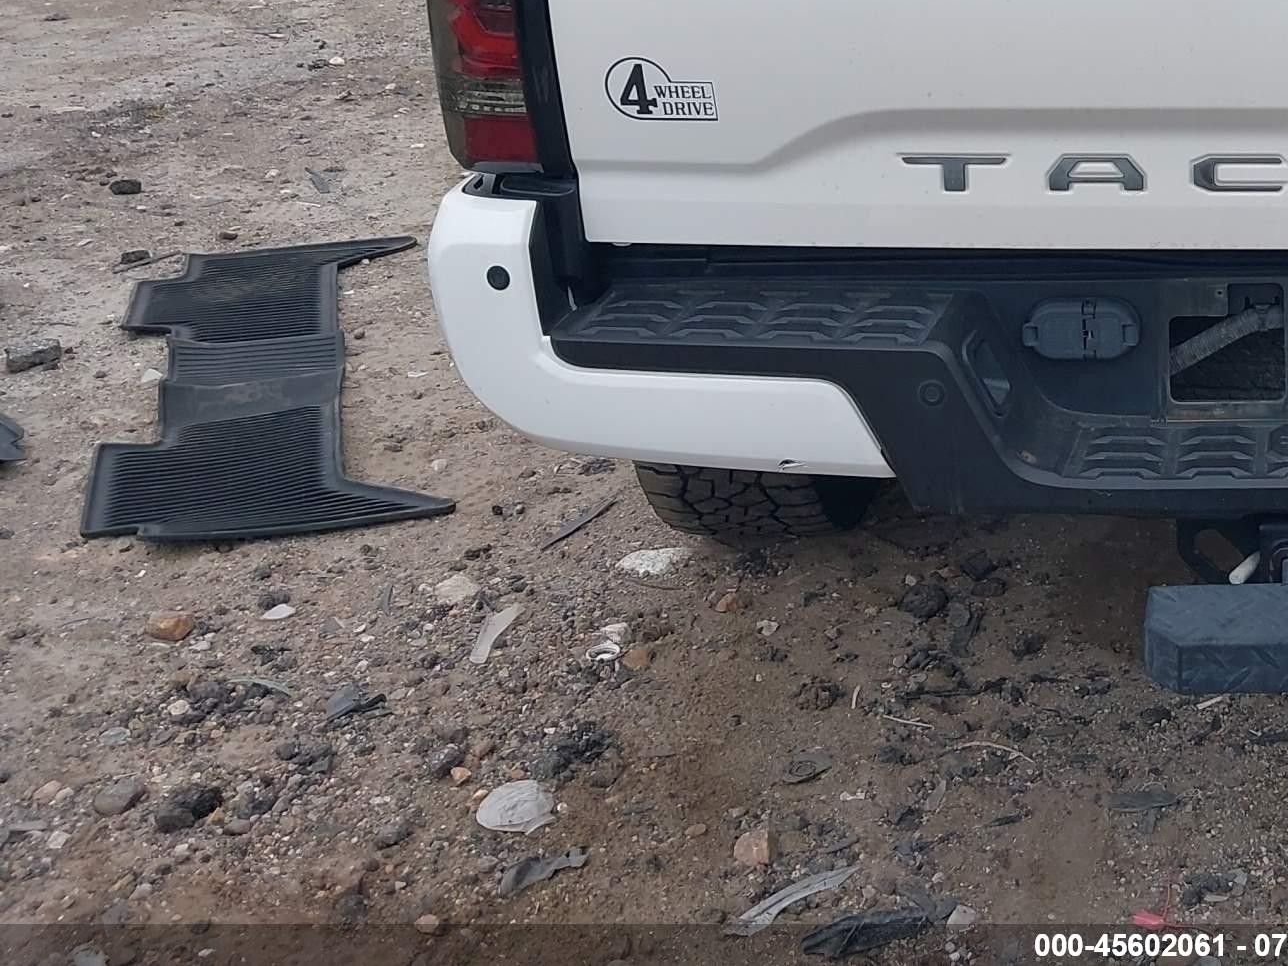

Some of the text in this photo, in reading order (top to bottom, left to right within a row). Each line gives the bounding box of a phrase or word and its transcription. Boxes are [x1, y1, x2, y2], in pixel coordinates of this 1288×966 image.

[620, 63, 658, 115] 4
[653, 85, 712, 99] WHEEL
[662, 101, 715, 116] DRIVE
